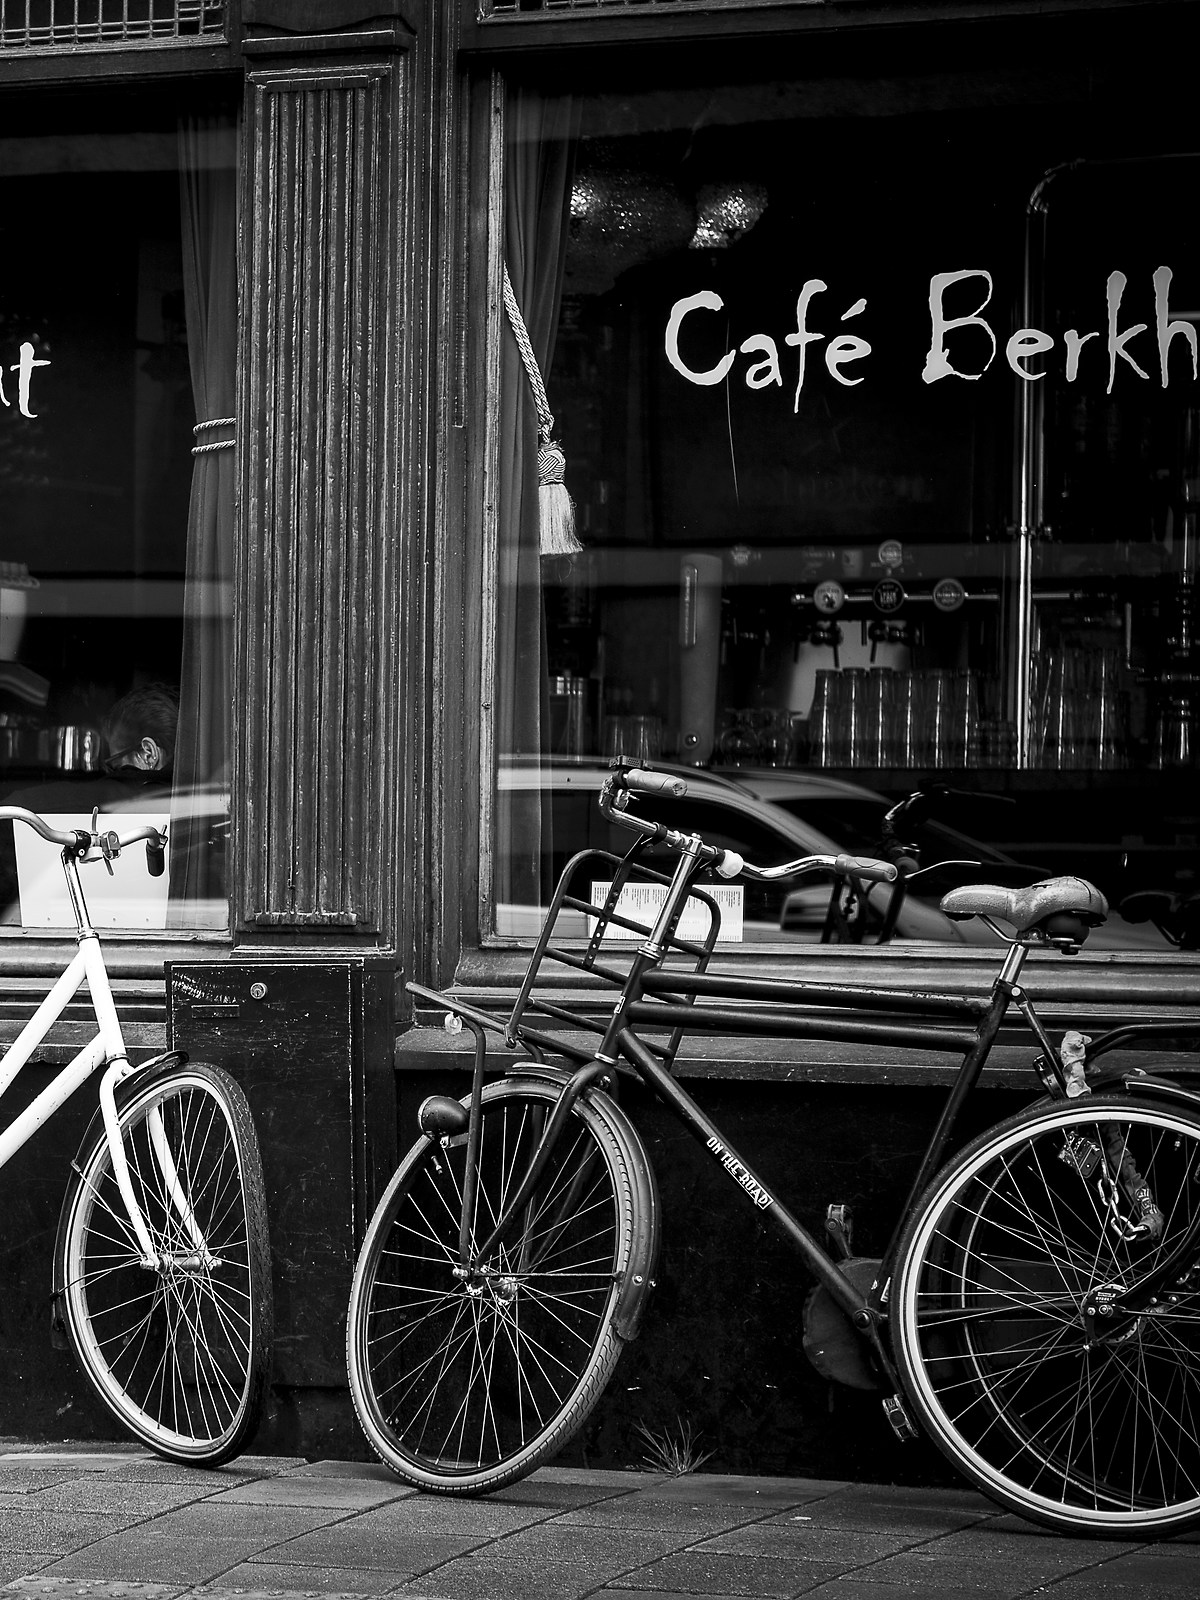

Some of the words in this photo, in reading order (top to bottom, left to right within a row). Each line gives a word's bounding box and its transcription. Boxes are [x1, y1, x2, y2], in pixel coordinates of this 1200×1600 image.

[665, 279, 872, 414] Café
[922, 266, 1199, 395] Berkh
[706, 1136, 724, 1155] ON
[720, 1151, 743, 1176] THE
[738, 1172, 770, 1206] ROAD
